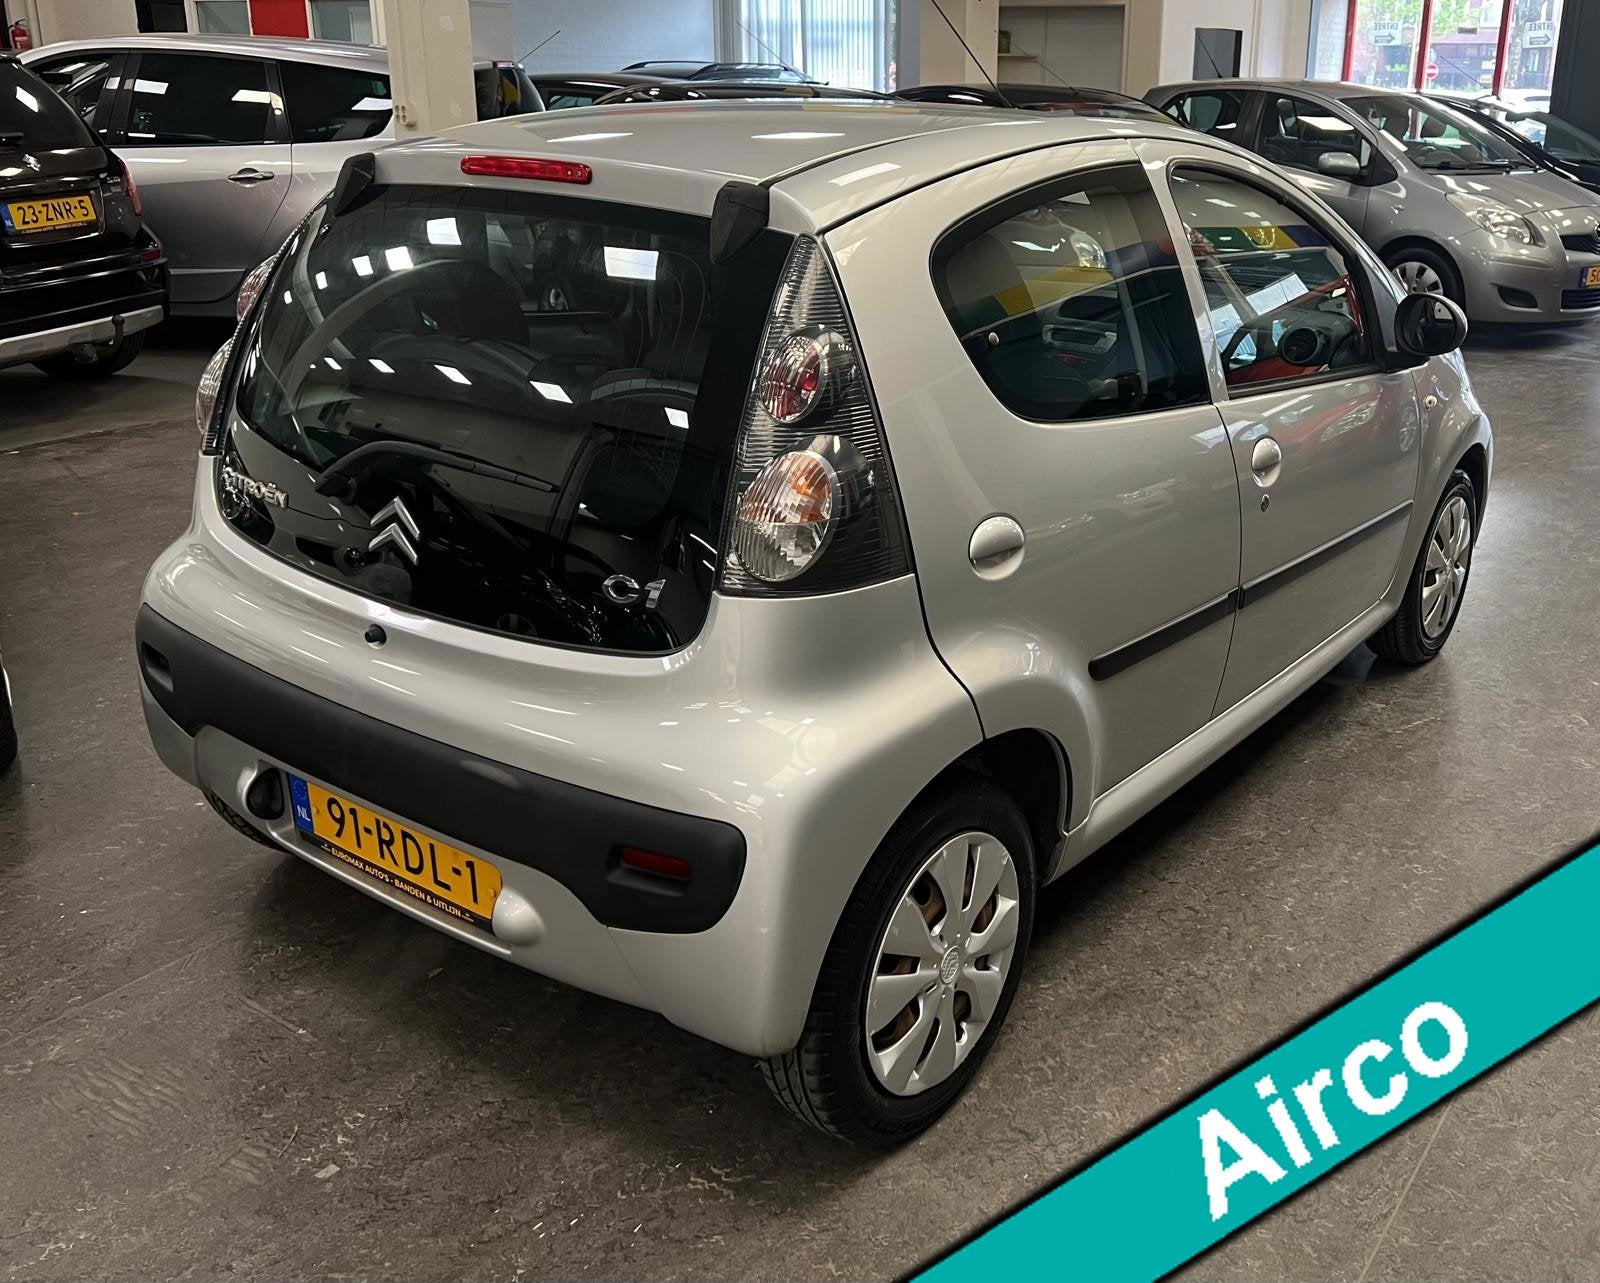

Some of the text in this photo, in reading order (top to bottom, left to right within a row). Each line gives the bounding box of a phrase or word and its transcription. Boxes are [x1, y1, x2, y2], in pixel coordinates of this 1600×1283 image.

[17, 199, 89, 225] 23-ZNR-5
[602, 574, 667, 609] C1
[297, 804, 311, 822] NL
[326, 797, 479, 905] 91-RDL-1
[331, 848, 364, 871] EUROMAX
[365, 864, 390, 883] AUTO'S
[394, 879, 426, 901] BANDEN
[426, 895, 432, 903] &
